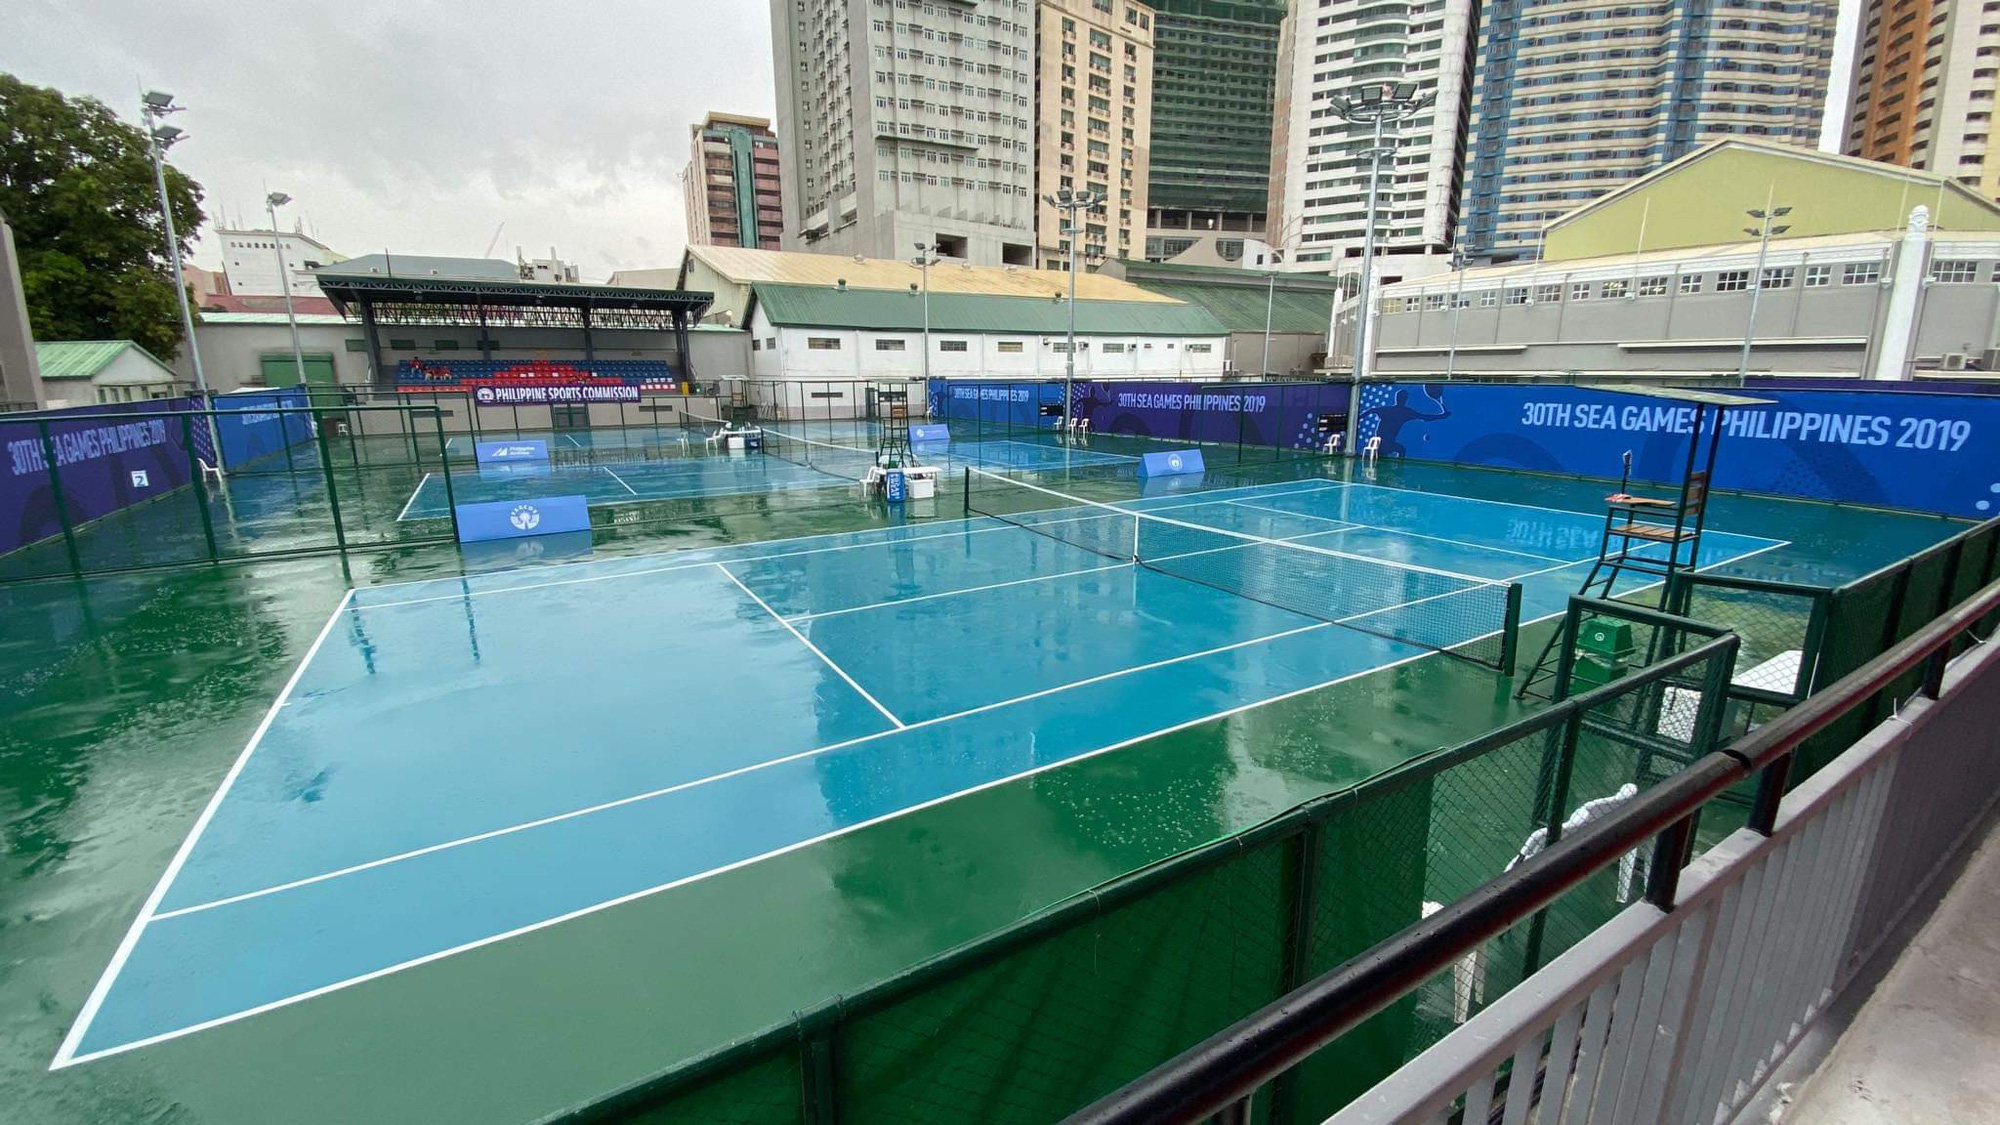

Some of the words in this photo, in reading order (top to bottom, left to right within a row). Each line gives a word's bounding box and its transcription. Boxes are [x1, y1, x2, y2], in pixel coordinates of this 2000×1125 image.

[495, 387, 548, 402] PHILIPPINE
[548, 386, 582, 401] SPORTS
[582, 386, 639, 400] COMMISSION
[1118, 393, 1137, 408] 30TH
[1137, 393, 1152, 409] SEA
[1154, 394, 1183, 410] GAMES
[1243, 395, 1266, 413] 2019
[1522, 402, 1570, 427] 30TH
[1573, 404, 1617, 430] SEA
[1895, 417, 1971, 452] 2019
[7, 438, 43, 475] 30TH
[63, 429, 100, 464] GAMES
[97, 421, 151, 456] PHILIPPINES
